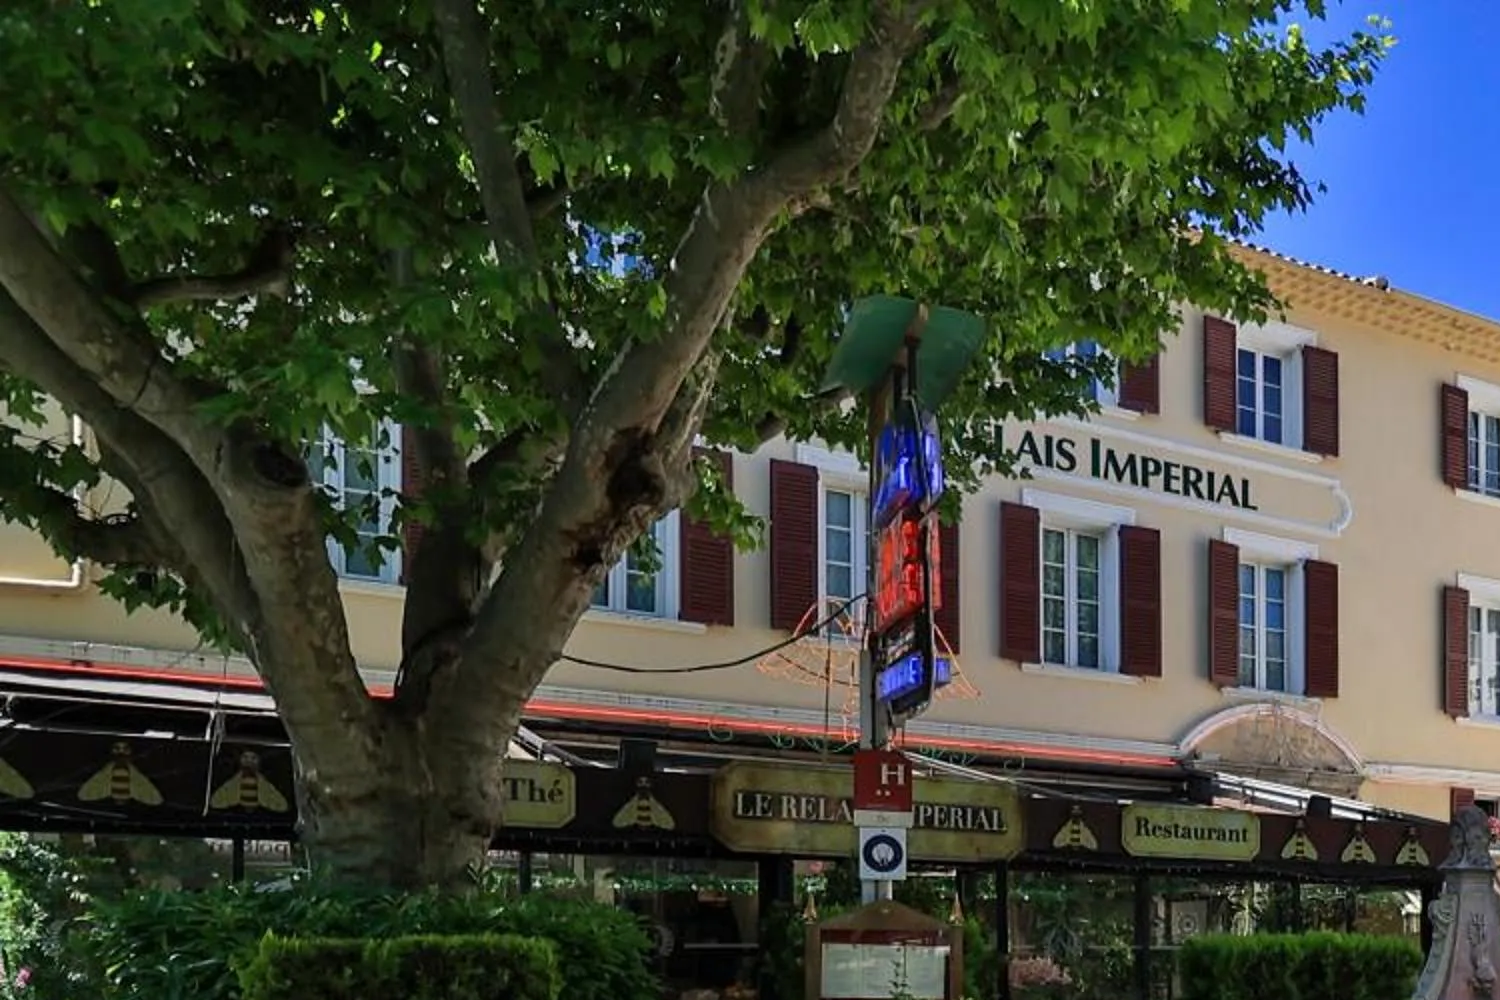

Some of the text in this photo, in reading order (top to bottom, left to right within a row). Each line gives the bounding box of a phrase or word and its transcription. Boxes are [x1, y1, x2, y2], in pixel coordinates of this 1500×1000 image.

[992, 424, 1077, 471] LAIS
[1091, 437, 1258, 510] IMPERIAL
[881, 763, 905, 785] H
[503, 778, 563, 803] Thé
[735, 792, 1008, 832] LE RELA PERIAL
[1135, 816, 1248, 843] Restaurant
